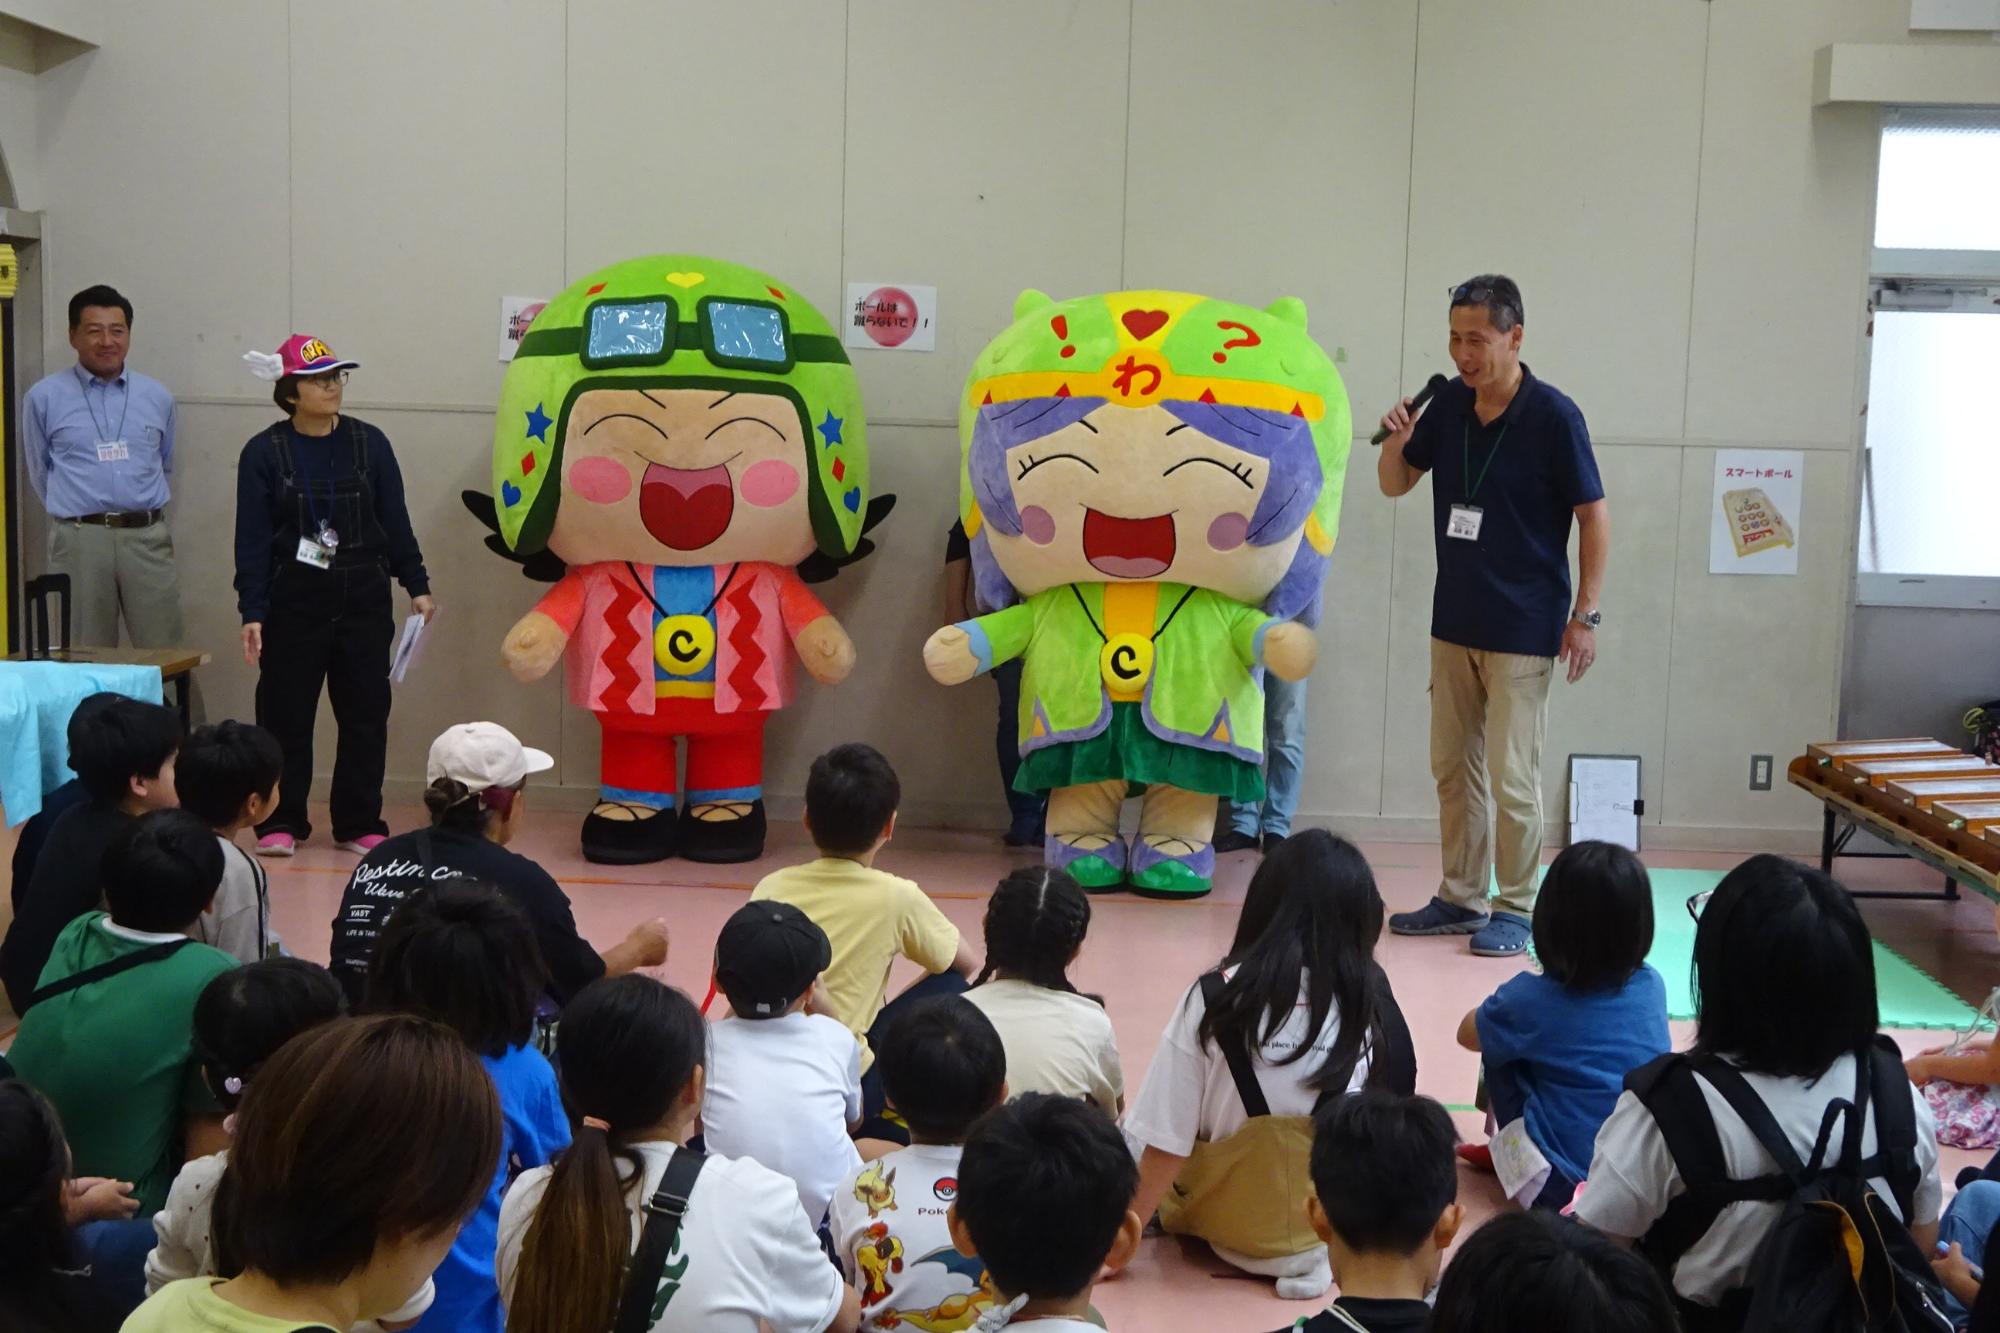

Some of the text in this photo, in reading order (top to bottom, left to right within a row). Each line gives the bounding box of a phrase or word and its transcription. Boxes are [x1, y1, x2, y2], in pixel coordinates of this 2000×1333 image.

[855, 299, 898, 313] ボールは
[1112, 355, 1162, 397] わ
[1725, 467, 1793, 479] スマートボール
